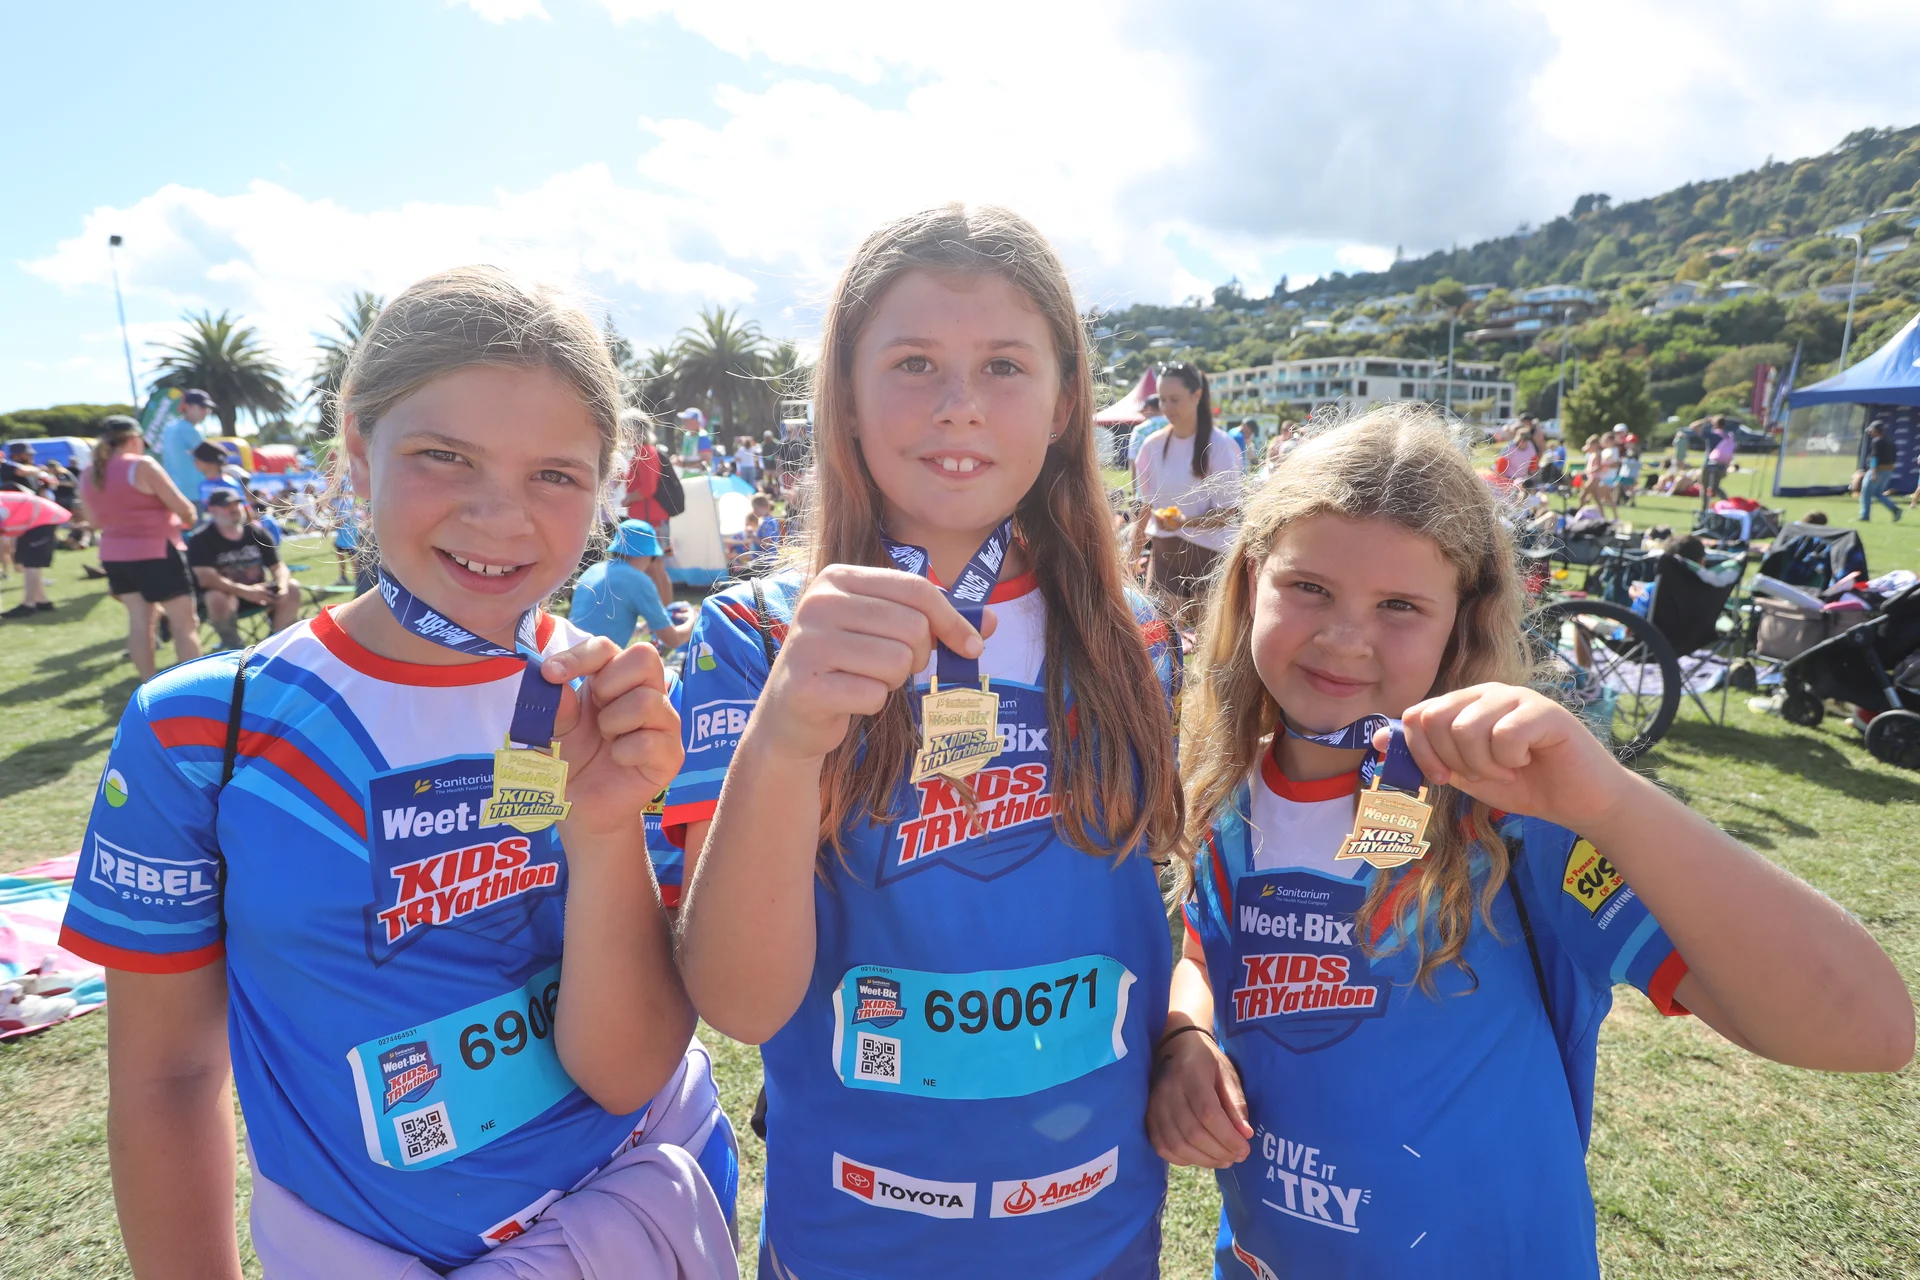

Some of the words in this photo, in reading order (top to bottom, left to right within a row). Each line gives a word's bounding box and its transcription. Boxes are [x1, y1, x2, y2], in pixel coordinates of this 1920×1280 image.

[697, 708, 752, 741] REB
[715, 739, 739, 749] SPO
[931, 730, 987, 753] KIDS
[922, 741, 998, 772] TRYathlon
[434, 773, 494, 789] Sanitariu
[918, 763, 1047, 816] KIDS
[500, 788, 554, 804] KIDS
[382, 797, 502, 841] Weet-
[490, 804, 564, 819] TRYathlon
[1363, 806, 1420, 830] Weet-Bix
[1347, 841, 1421, 855] TRYathlon
[1360, 828, 1414, 844] KIDS
[99, 848, 212, 896] REBEL
[390, 837, 531, 902] KIDS
[122, 891, 176, 906] SPORT
[377, 863, 558, 944] TRYathlon
[1276, 886, 1330, 900] Sanitarium
[1308, 899, 1329, 907] Company
[1240, 905, 1355, 946] Weet-Bix
[1242, 953, 1350, 987] KIDS
[859, 985, 899, 999] Weet-Bix
[862, 999, 896, 1009] KIDS
[924, 968, 1099, 1035] 690671
[1232, 984, 1377, 1023] TRYathlon
[857, 1008, 904, 1020] TRYathlon
[383, 1052, 427, 1073] Weet-Bix
[386, 1069, 438, 1106] TRYathlon
[388, 1064, 428, 1090] KIDS
[923, 1078, 937, 1087] NE
[480, 1119, 496, 1132] NE
[1263, 1132, 1320, 1177] GIVE
[1321, 1164, 1337, 1181] IT
[878, 1181, 964, 1208] TOYOTA
[1038, 1167, 1109, 1202] Anchor
[1266, 1165, 1275, 1182] A
[1277, 1168, 1362, 1226] TRY
